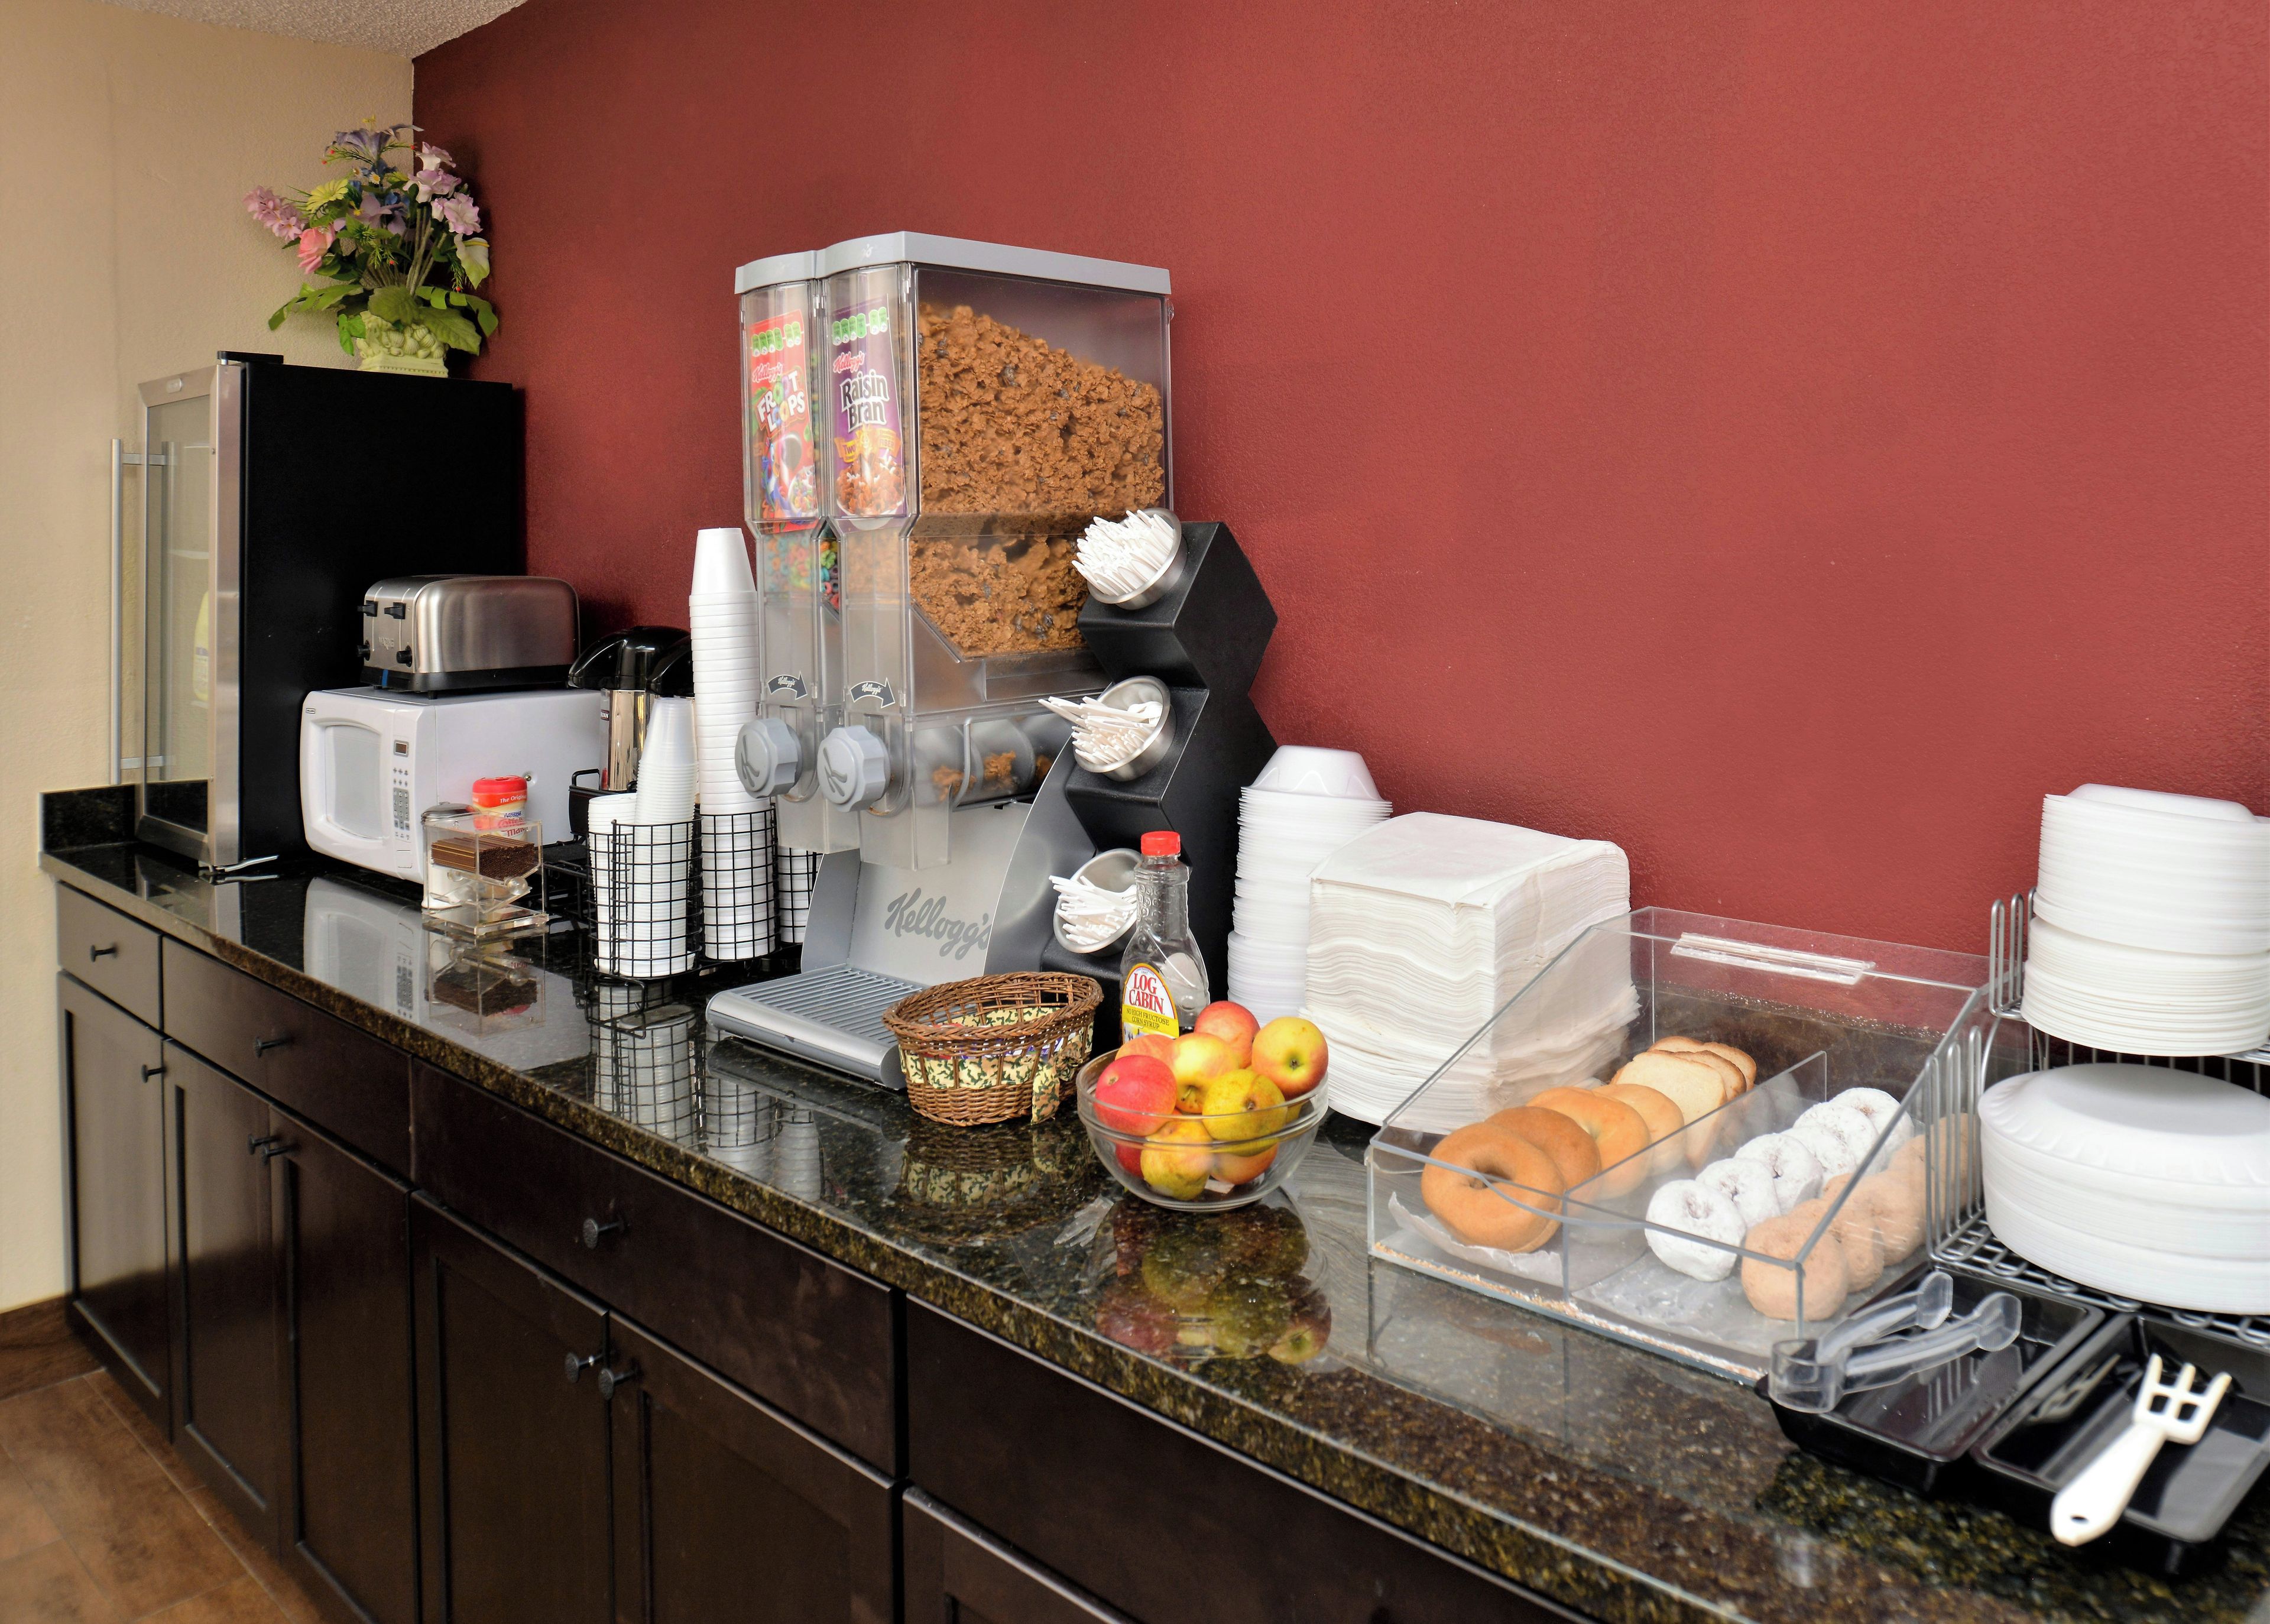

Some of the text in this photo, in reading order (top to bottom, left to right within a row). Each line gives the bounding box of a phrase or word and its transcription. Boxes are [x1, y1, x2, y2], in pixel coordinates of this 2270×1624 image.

[753, 362, 783, 383] Kellogg's
[834, 351, 865, 373] Kellogg's
[840, 370, 889, 411] Raisin
[767, 391, 806, 432] LOOPS
[848, 401, 887, 432] Bran
[778, 676, 795, 688] Kellogg's
[861, 682, 881, 695] Kellogg's
[884, 887, 993, 960] Kellogg's
[1134, 973, 1157, 994] LOG
[1129, 989, 1164, 1014] CABIN
[1131, 1009, 1142, 1017] HIGH
[1143, 1012, 1170, 1026] FRUCTOSE
[1131, 1016, 1160, 1029] CORN SYRUP
